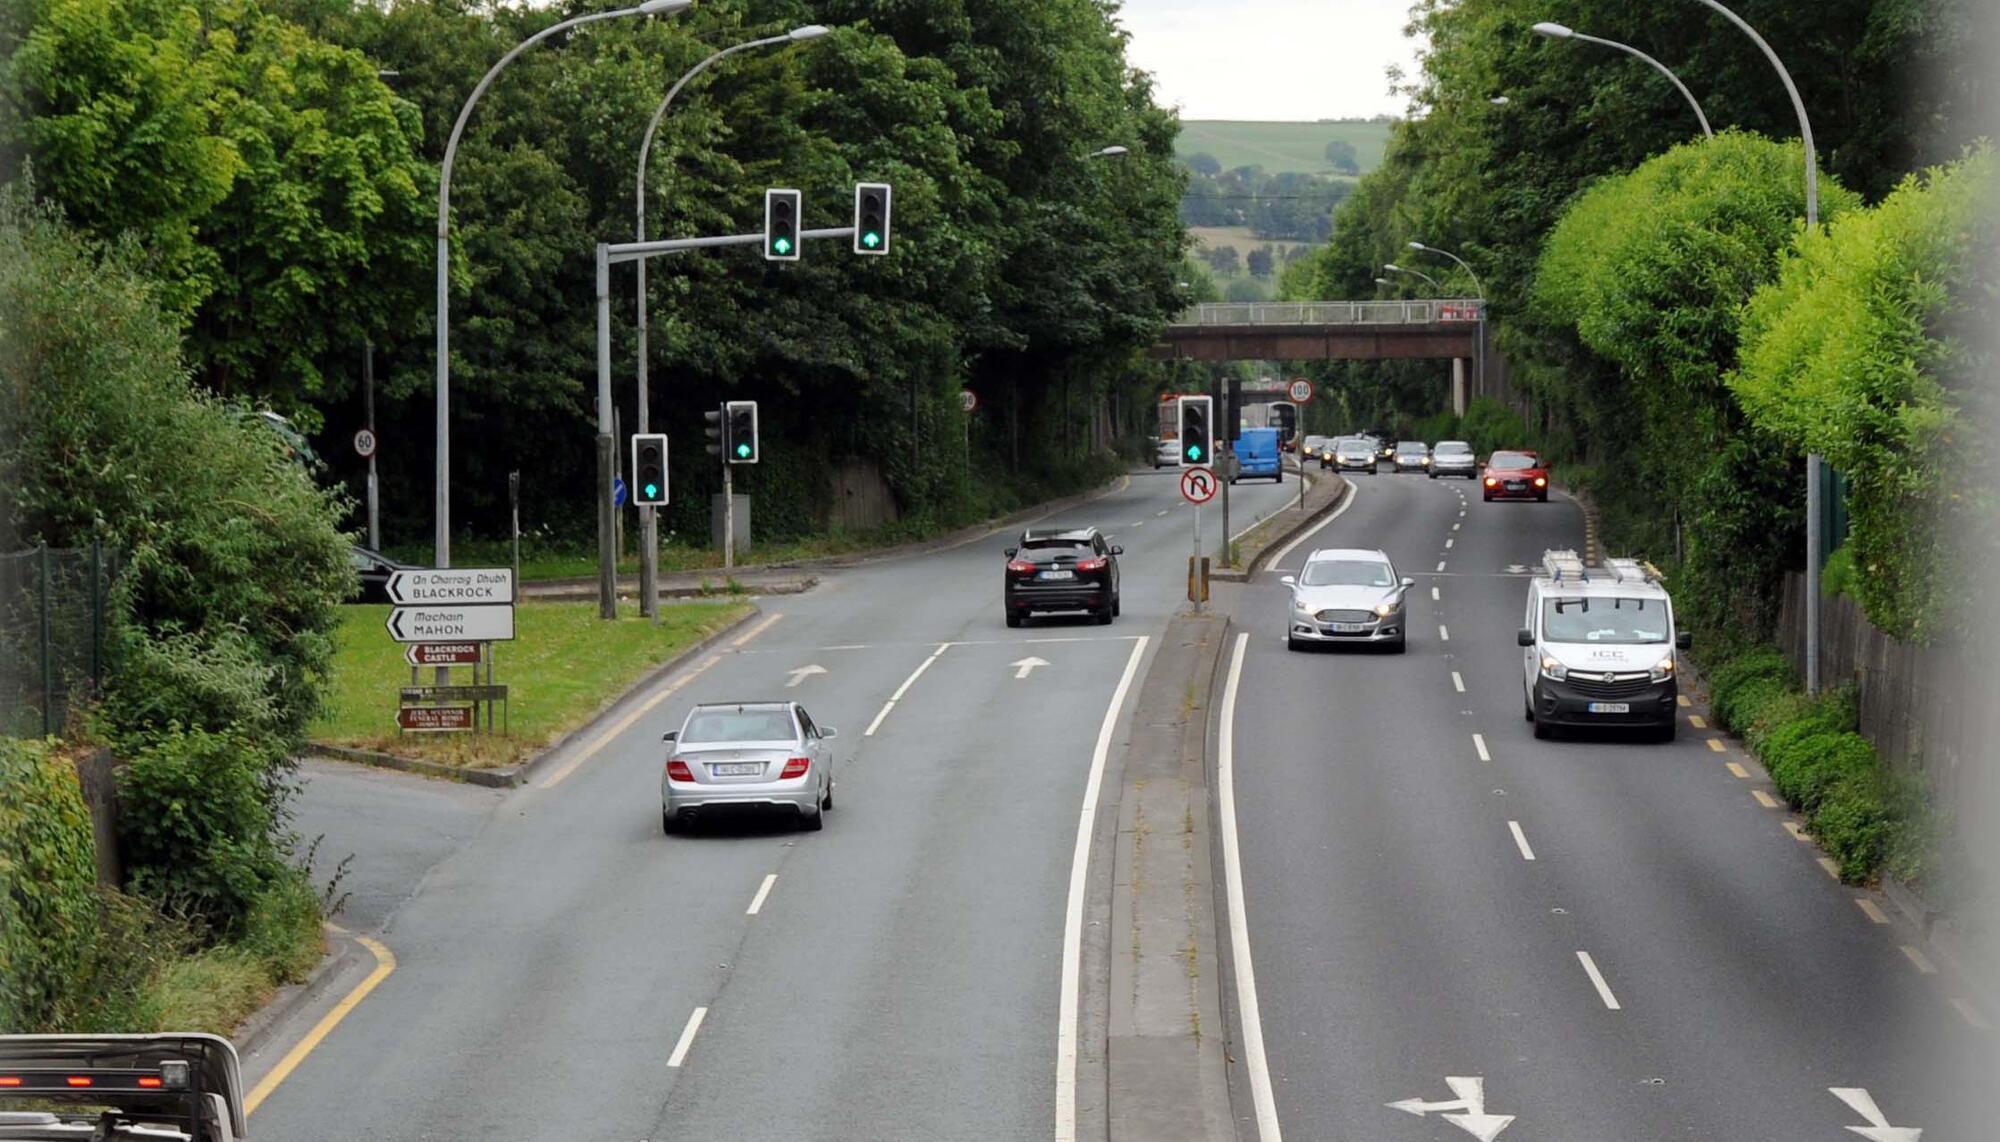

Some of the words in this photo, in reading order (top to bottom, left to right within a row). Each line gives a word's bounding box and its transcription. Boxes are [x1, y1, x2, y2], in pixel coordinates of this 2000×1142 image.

[1293, 384, 1309, 395] 100
[358, 434, 372, 448] 60
[431, 575, 471, 585] Charraig
[477, 574, 506, 584] Dhubh
[413, 587, 493, 598] BLACKROCK
[415, 612, 463, 621] Machain
[414, 625, 463, 635] MAHON
[424, 645, 475, 653] BLACKROCK
[424, 654, 456, 662] CASTLE
